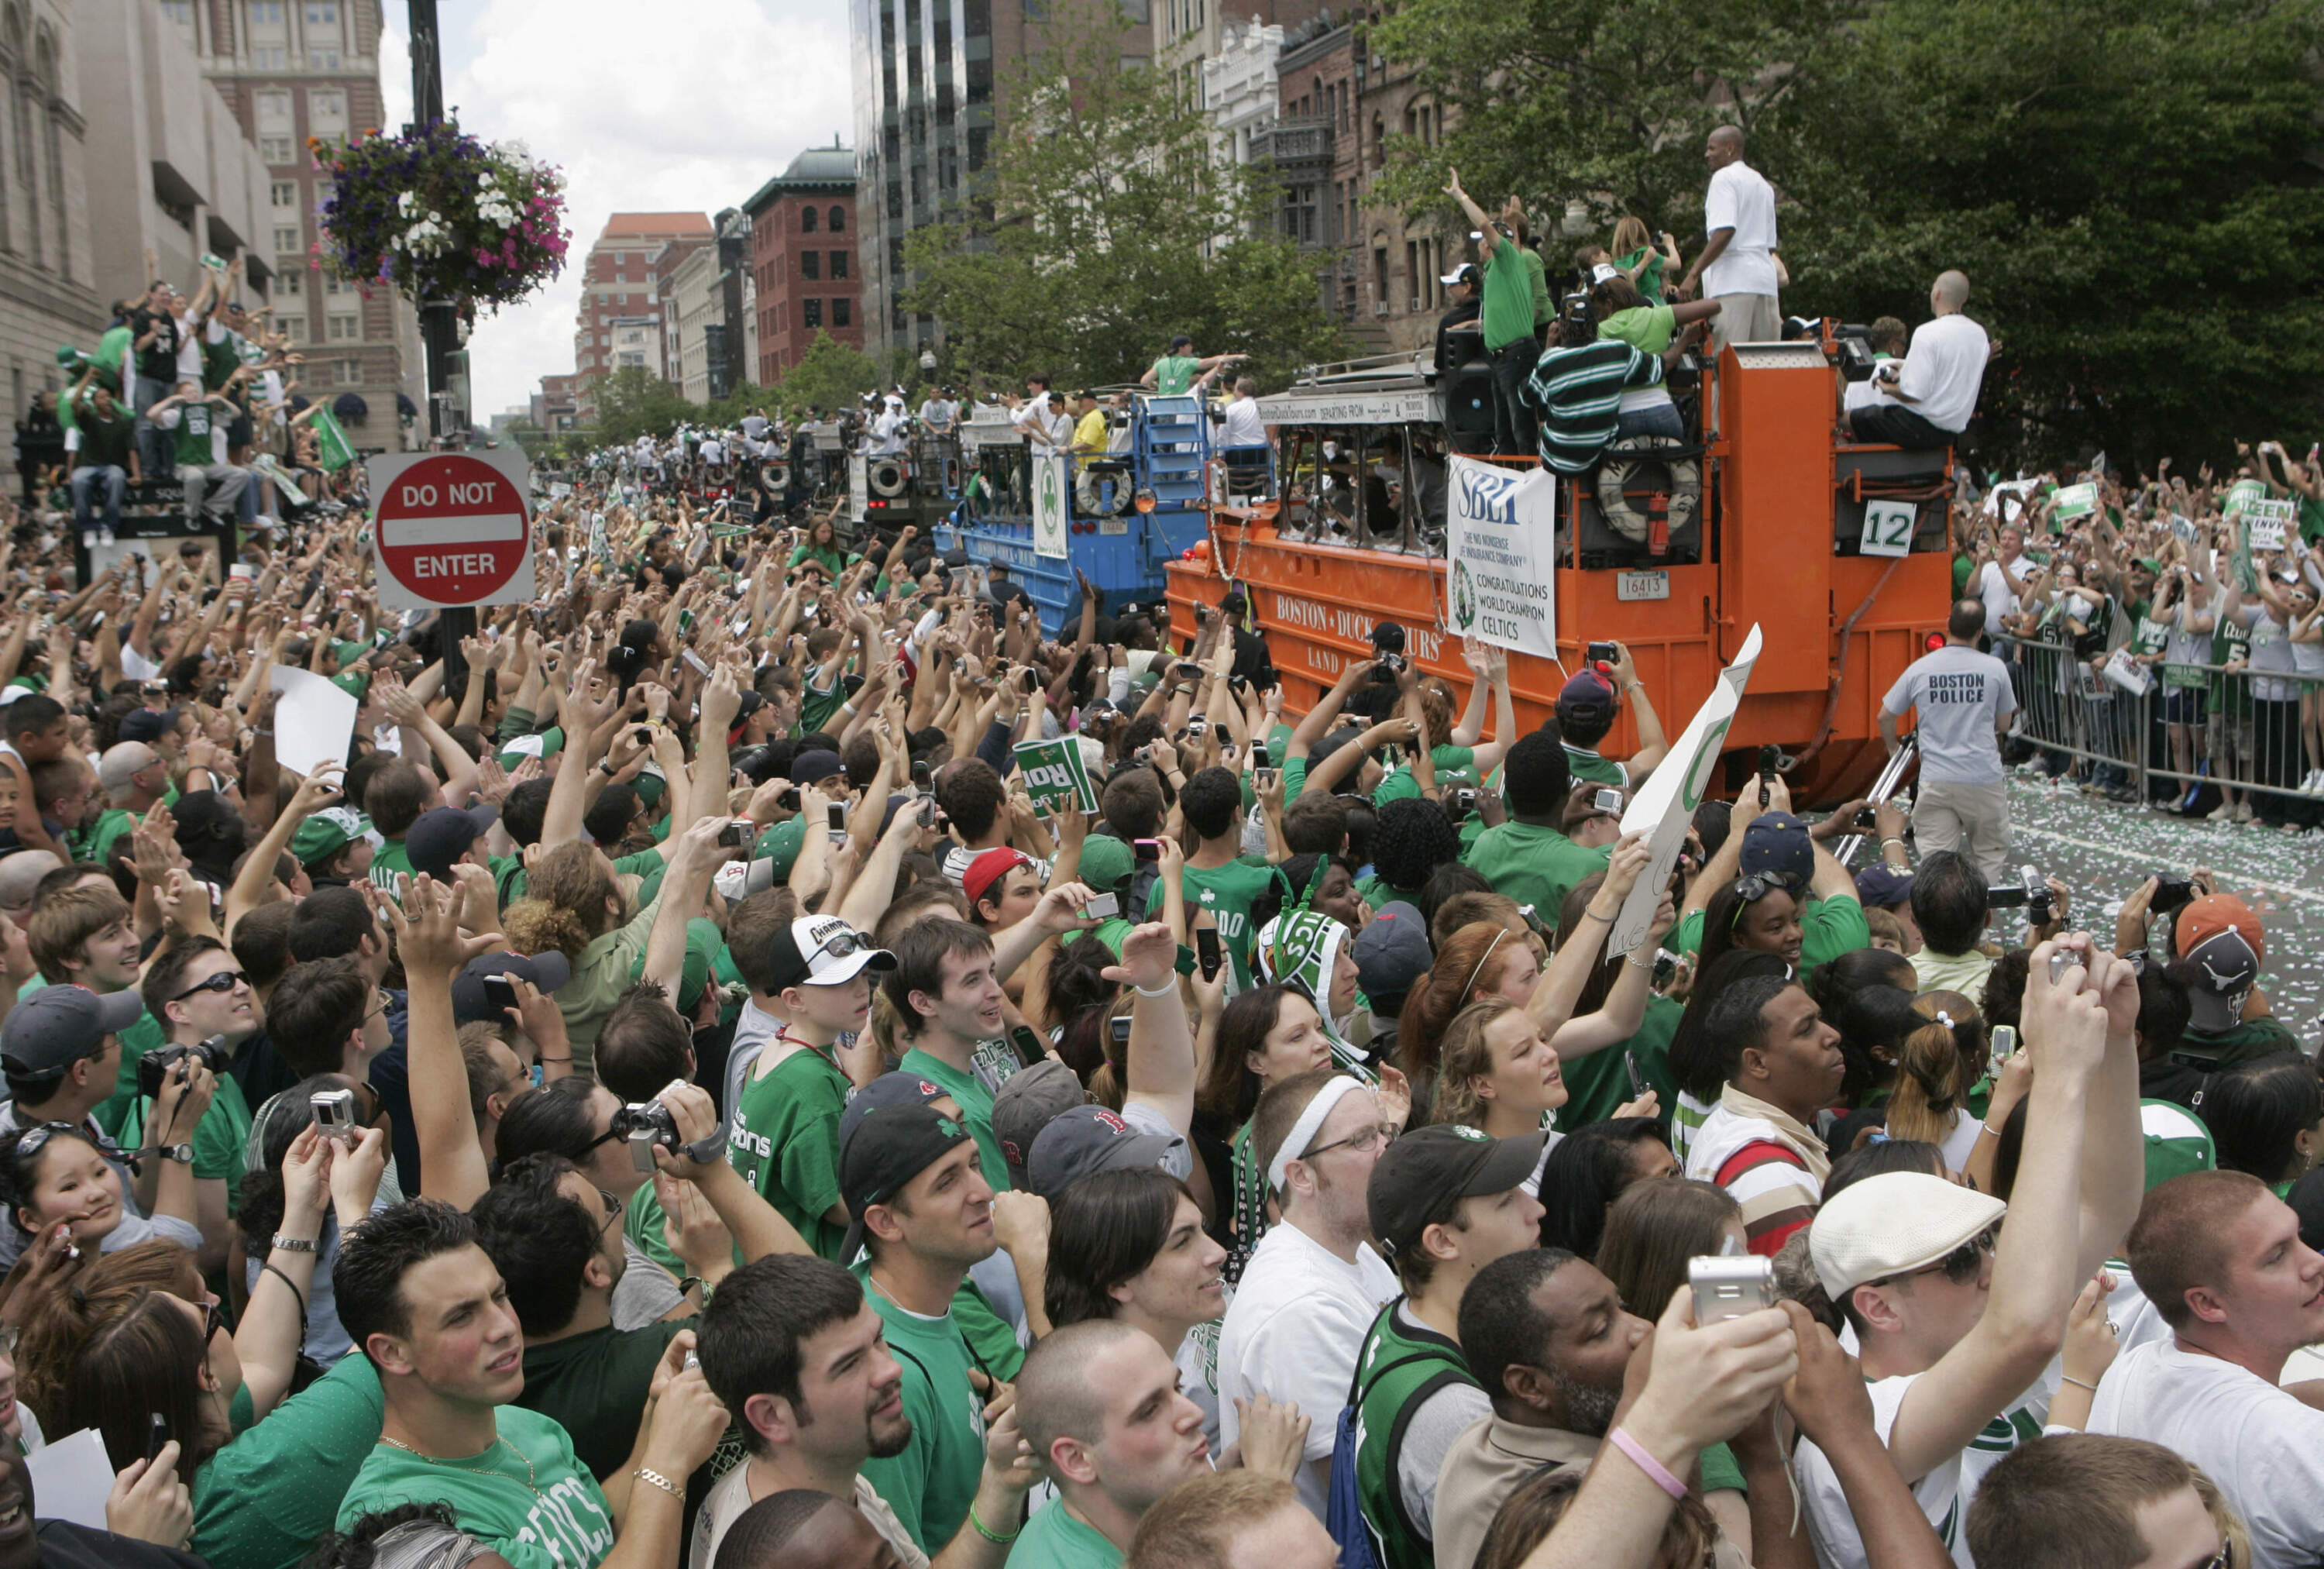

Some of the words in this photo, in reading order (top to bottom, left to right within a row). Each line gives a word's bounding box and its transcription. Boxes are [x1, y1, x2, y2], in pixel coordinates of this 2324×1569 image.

[1320, 405, 1347, 420] DEPARTING
[1348, 404, 1363, 417] FROM
[402, 484, 438, 508] DO
[449, 481, 496, 505] NOT
[1459, 468, 1520, 525] SBLI
[1464, 532, 1473, 544] THE
[1473, 533, 1481, 545] NO
[1481, 535, 1508, 550] NONSENSE
[1864, 511, 1911, 546] 12
[414, 553, 496, 577] ENTER
[1466, 545, 1496, 563] INSURANCE
[1477, 573, 1548, 600] CONGRATULATIONS
[1626, 578, 1660, 594] 16413
[1479, 595, 1504, 612] WORLD
[1505, 600, 1545, 621] CHAMPION
[1277, 595, 1326, 631] BOSTON
[1337, 610, 1374, 644] DUCK
[1400, 625, 1439, 662] URS
[1482, 616, 1518, 641] CELTICS
[1308, 647, 1339, 673] LAND
[1929, 673, 1985, 689] BOSTON
[1930, 689, 1984, 704] POLICE
[1094, 1110, 1126, 1135] B
